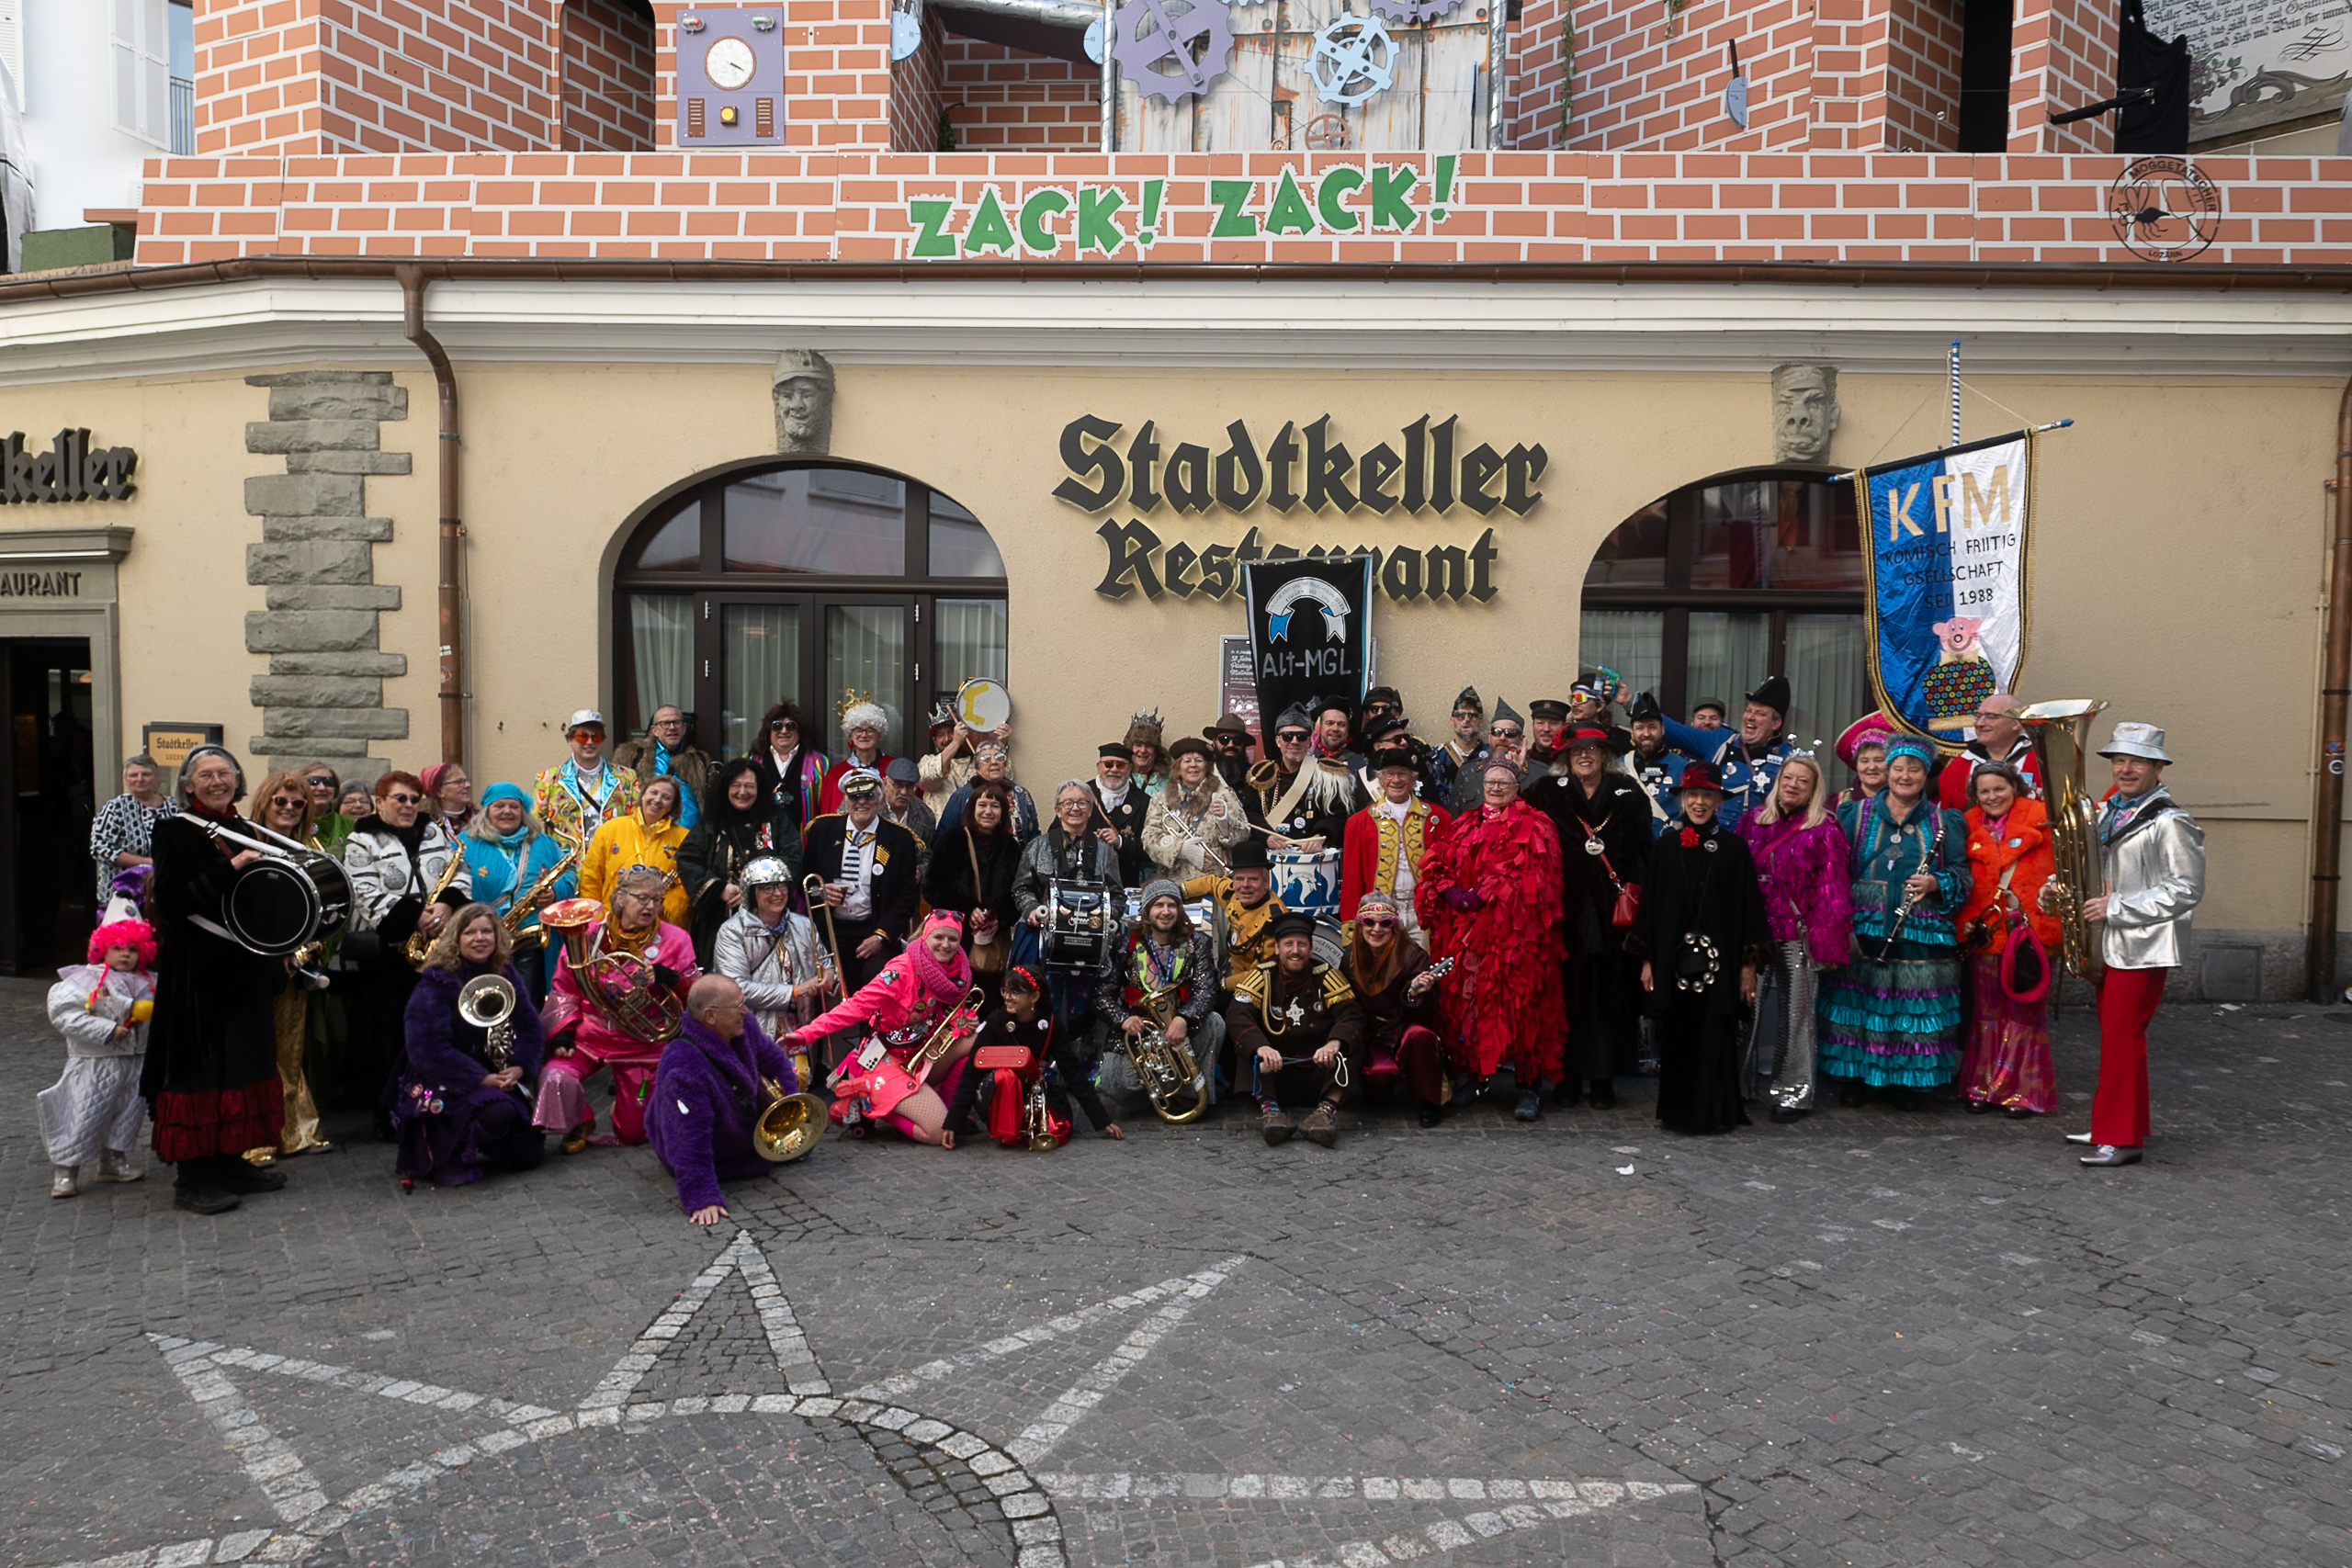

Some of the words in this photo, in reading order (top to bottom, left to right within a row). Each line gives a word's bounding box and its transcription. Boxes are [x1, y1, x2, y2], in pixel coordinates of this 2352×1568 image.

[910, 179, 1166, 257] ZACK!
[1211, 154, 1457, 238] ZACK!
[0, 427, 140, 505] keller
[1052, 412, 1549, 517] Stadtkeller
[1888, 464, 2011, 542] KFM
[1884, 540, 1956, 567] KOMISCH
[1965, 533, 2016, 555] FRIITIG
[0, 571, 82, 597] AURANT
[1904, 560, 2004, 586] GSELLSCHAFT
[1959, 588, 1994, 606] 1988
[1261, 647, 1351, 679] Alt-MGL
